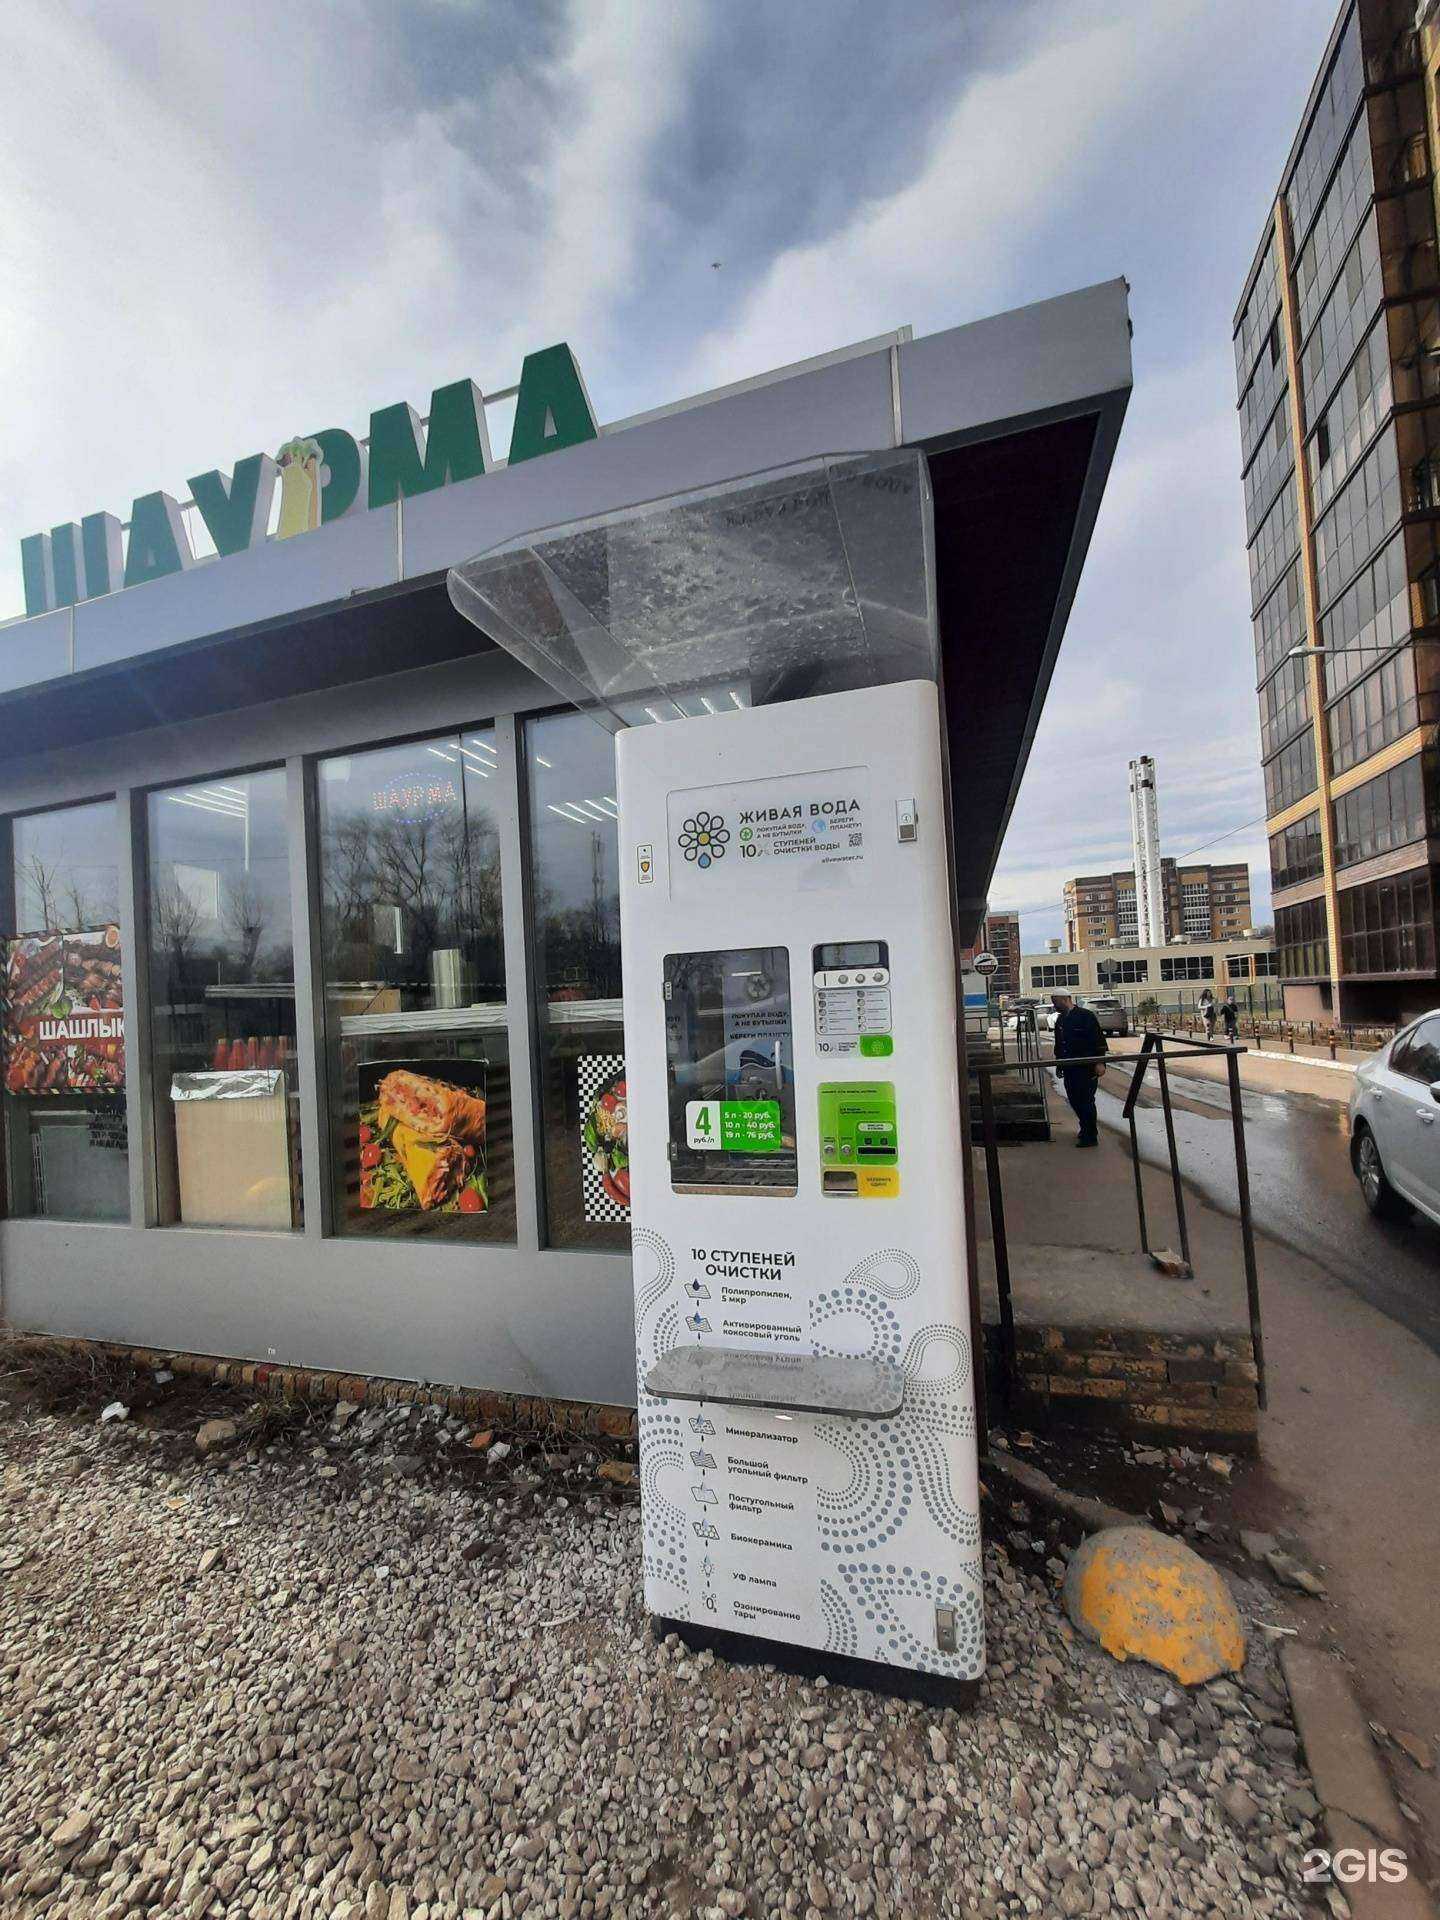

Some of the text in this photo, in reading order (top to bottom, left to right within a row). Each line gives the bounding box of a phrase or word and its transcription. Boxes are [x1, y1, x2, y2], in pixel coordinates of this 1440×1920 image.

[20, 342, 600, 618] ШАУРМА
[373, 781, 457, 810] ШАУРМА
[739, 799, 861, 824] ЖИВАЯ ВОДА
[773, 837, 816, 848] СТУПЕНЕЙ
[773, 843, 840, 855] ОЧИСТКИ ВОДЫ
[739, 844, 757, 858] 10
[818, 1043, 830, 1053] 10
[695, 1106, 712, 1135] 4
[754, 1111, 771, 1120] руб.
[759, 1121, 776, 1130] руб.
[758, 1131, 774, 1140] руб.
[691, 1248, 795, 1267] 10 СТУПЕНЕЙ
[705, 1264, 782, 1280] ОЧИСТКИ
[721, 1286, 792, 1300] Полипропилен,
[722, 1320, 802, 1334] Активированный
[723, 1329, 801, 1342] кокосовый уголь
[725, 1427, 798, 1444] Минерализатор
[727, 1456, 769, 1469] Большой
[727, 1466, 809, 1485] угольный фильтр
[728, 1493, 795, 1510] Постугольный
[728, 1502, 763, 1515] фильтр
[730, 1533, 793, 1550] Биокерамика
[732, 1572, 777, 1587] УФ лампа
[733, 1601, 801, 1620] Озонирование
[733, 1609, 757, 1620] тары
